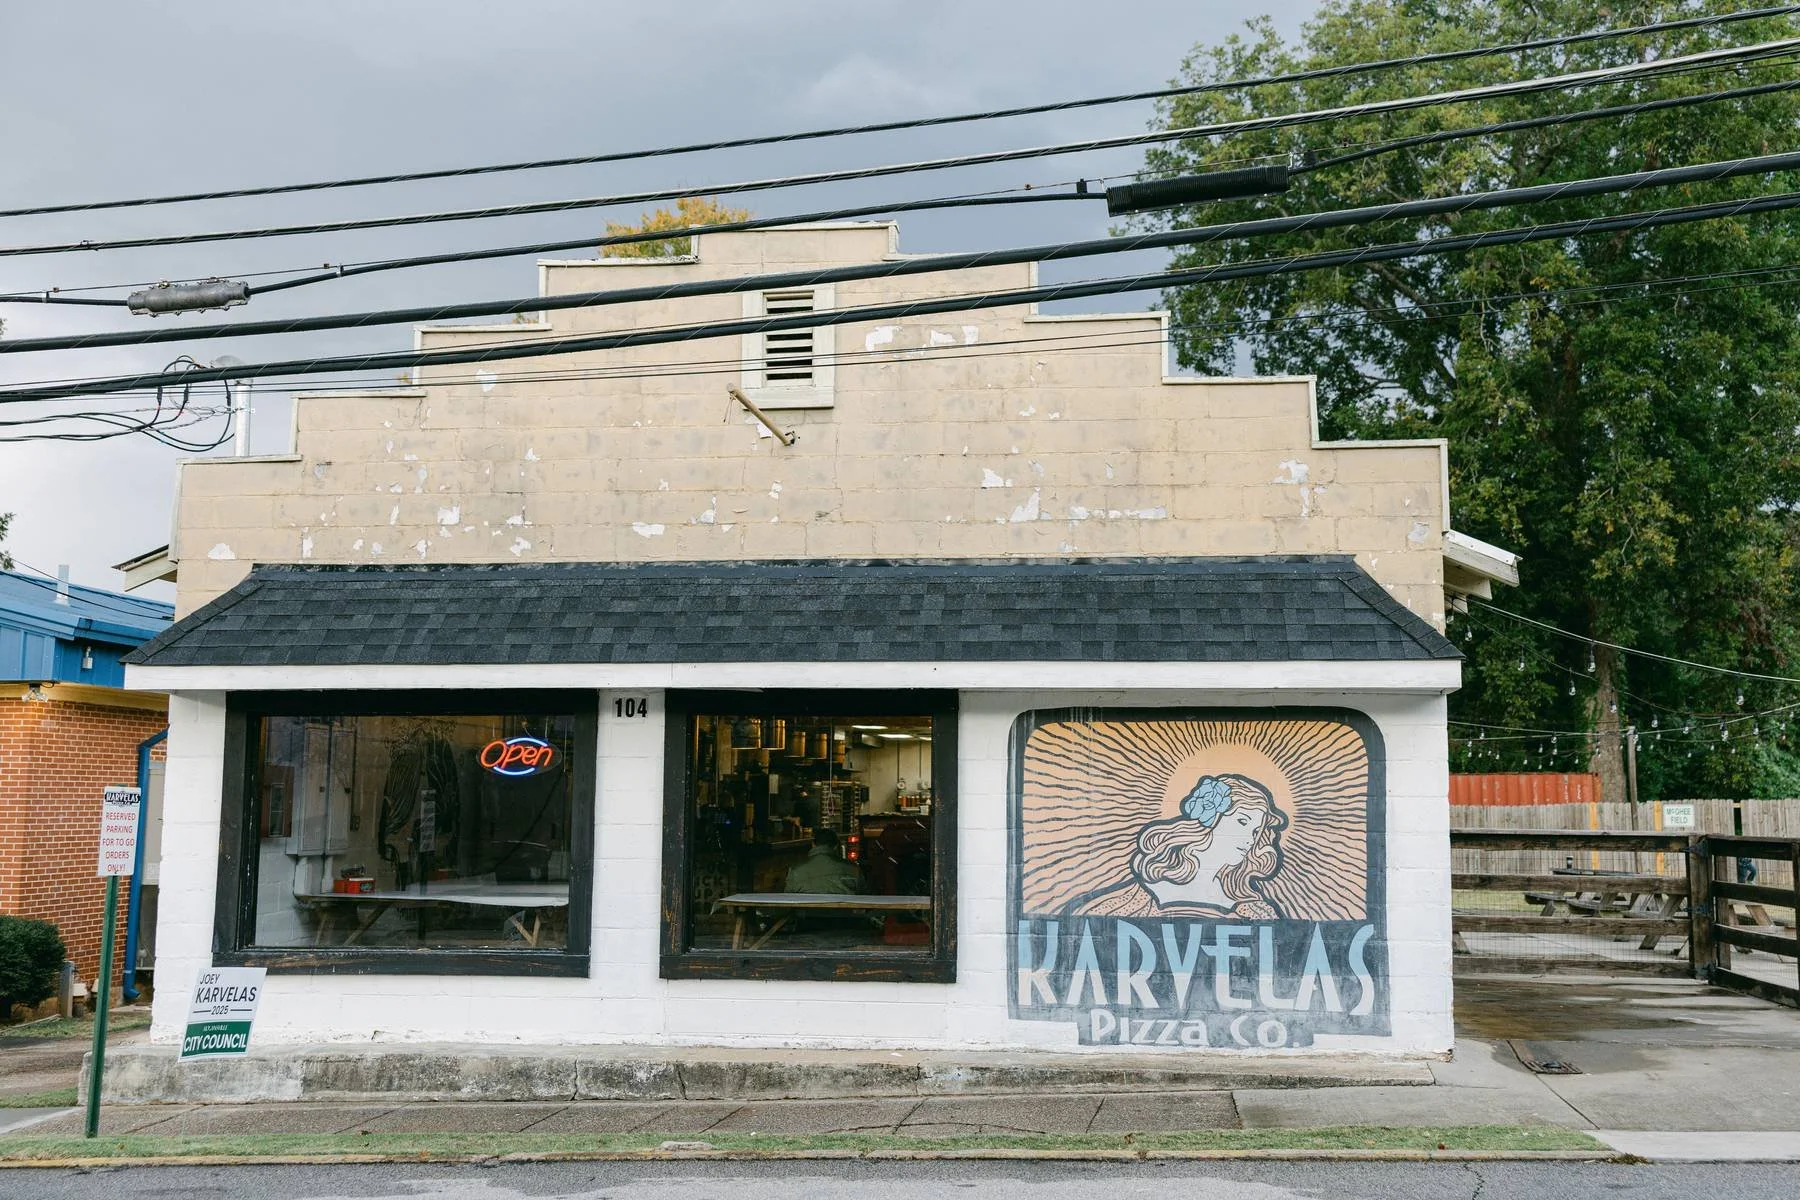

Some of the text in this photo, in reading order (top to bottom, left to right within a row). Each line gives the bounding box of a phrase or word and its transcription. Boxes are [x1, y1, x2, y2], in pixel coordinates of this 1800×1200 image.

[615, 698, 648, 718] 104
[480, 740, 553, 770] Open
[106, 792, 139, 803] KARVELAS
[105, 812, 136, 821] RESERVED
[1670, 816, 1688, 824] FIELD
[106, 825, 133, 833] PARKING
[102, 838, 135, 847] FOR TO GO
[105, 851, 130, 859] ORDERS
[1018, 917, 1375, 1016] KARVELAS
[200, 973, 220, 985] JOEY
[195, 986, 257, 1004] KARVELAS
[211, 1005, 229, 1015] 2025
[1090, 1008, 1301, 1049] Pizza Co.
[183, 1033, 247, 1053] CITY COUNCIL
